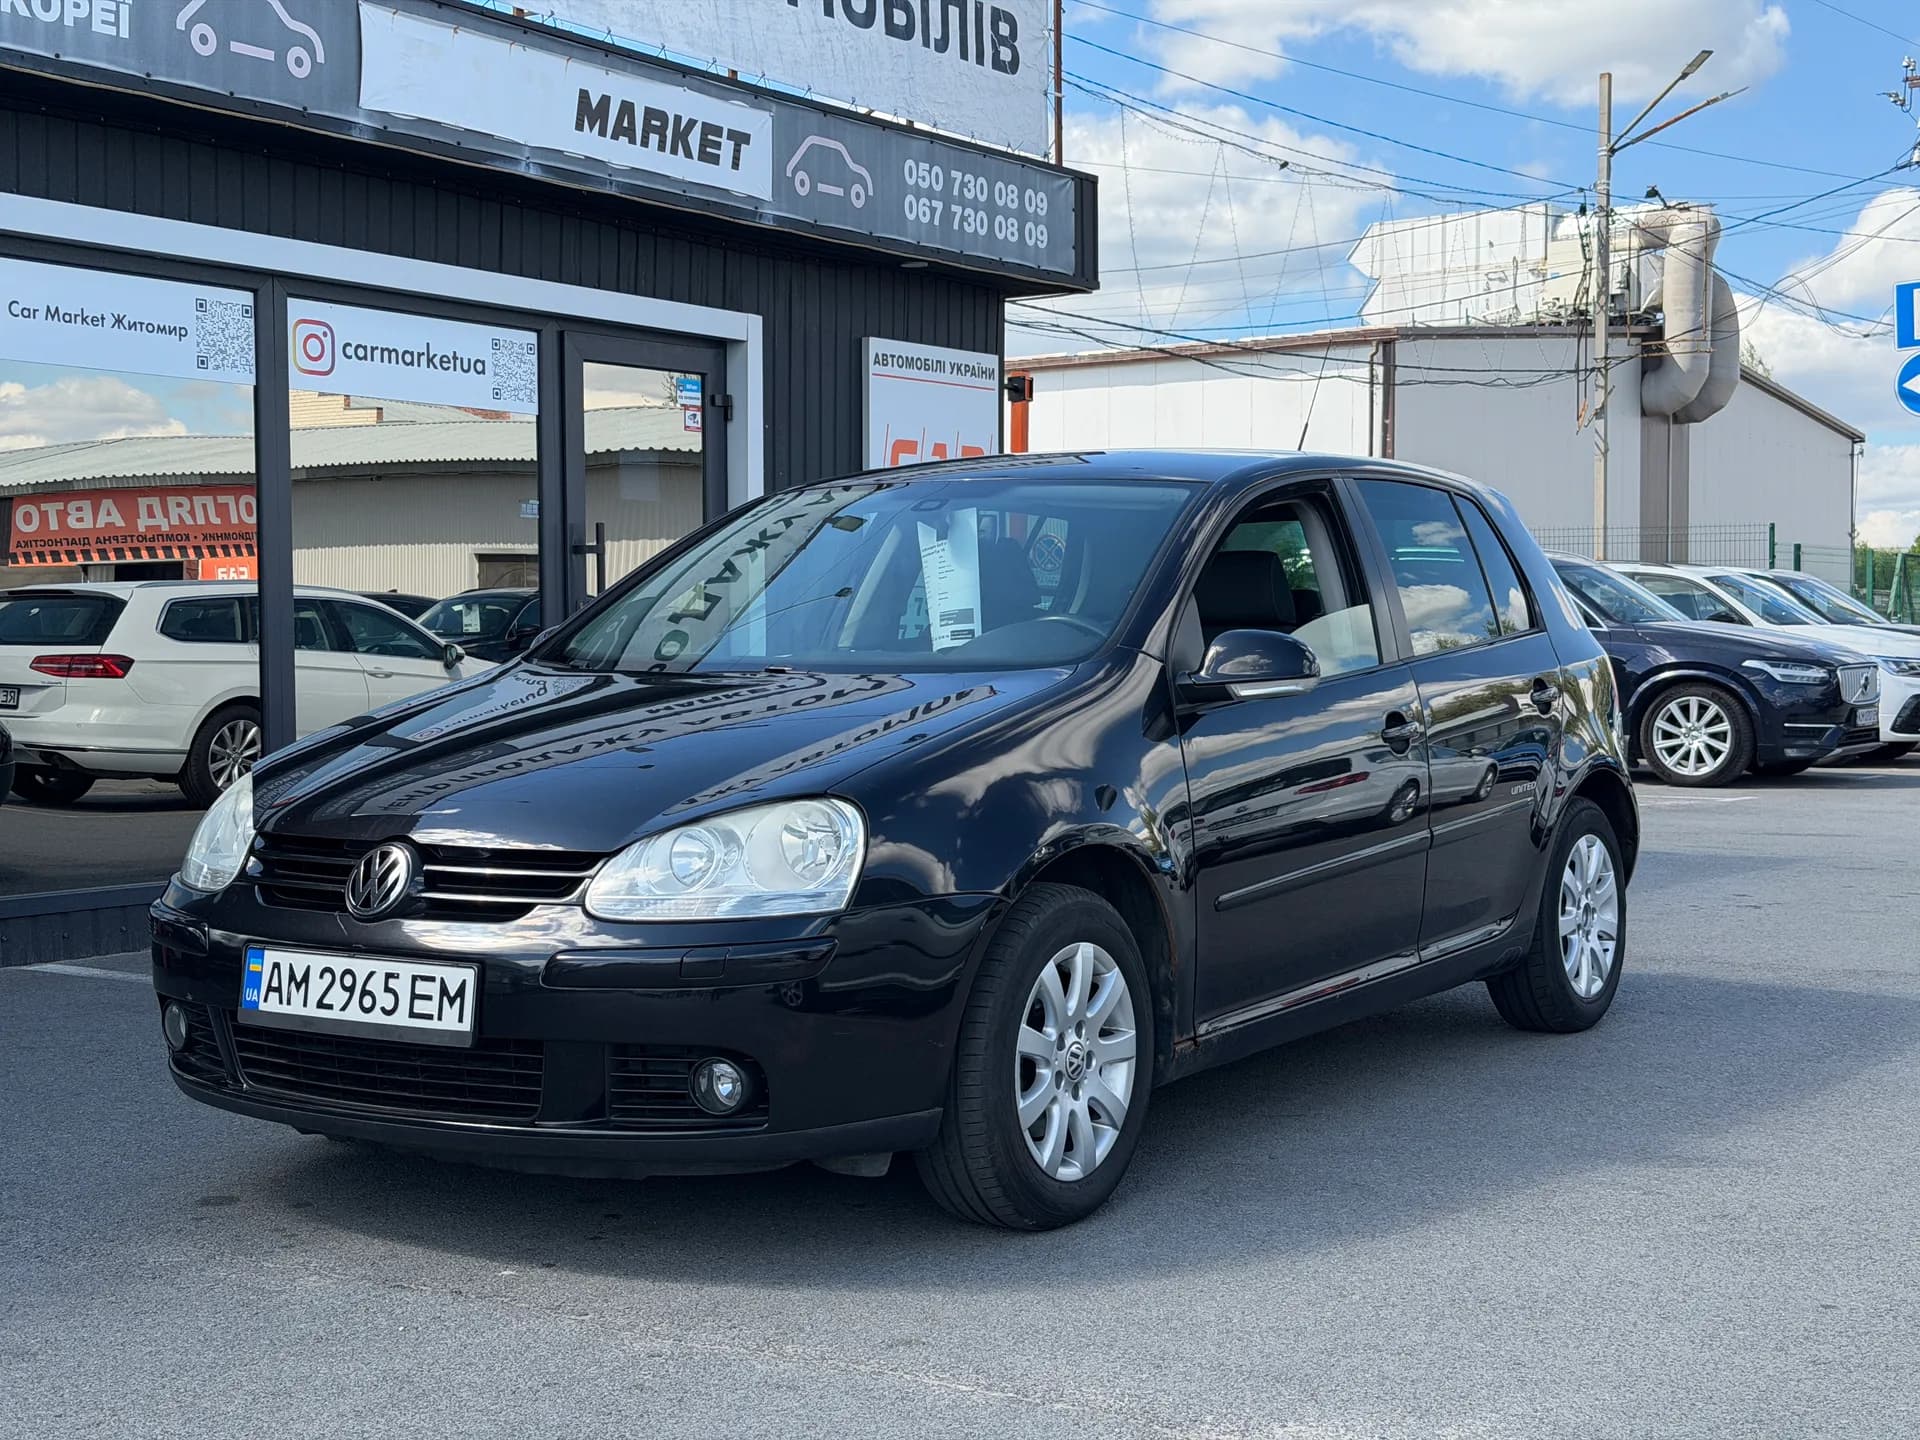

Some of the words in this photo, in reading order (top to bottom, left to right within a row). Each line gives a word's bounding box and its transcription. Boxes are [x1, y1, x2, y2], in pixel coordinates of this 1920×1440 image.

[786, 0, 1020, 75] БІЛІВ
[574, 87, 752, 171] MARKET
[904, 158, 944, 192] 050
[950, 170, 988, 202] 730
[994, 180, 1019, 210] 08
[1024, 188, 1048, 216] 09
[904, 194, 944, 226] 067
[951, 204, 988, 236] 730
[994, 214, 1019, 242] 08
[1024, 221, 1048, 249] 09
[8, 300, 40, 320] Car
[44, 304, 106, 328] Market
[110, 312, 189, 342] Житомир
[341, 341, 487, 376] carmarketua
[873, 351, 946, 374] АВТОМОБІЛІ
[949, 361, 996, 381] УКРАЇНИ
[245, 986, 258, 1002] UA
